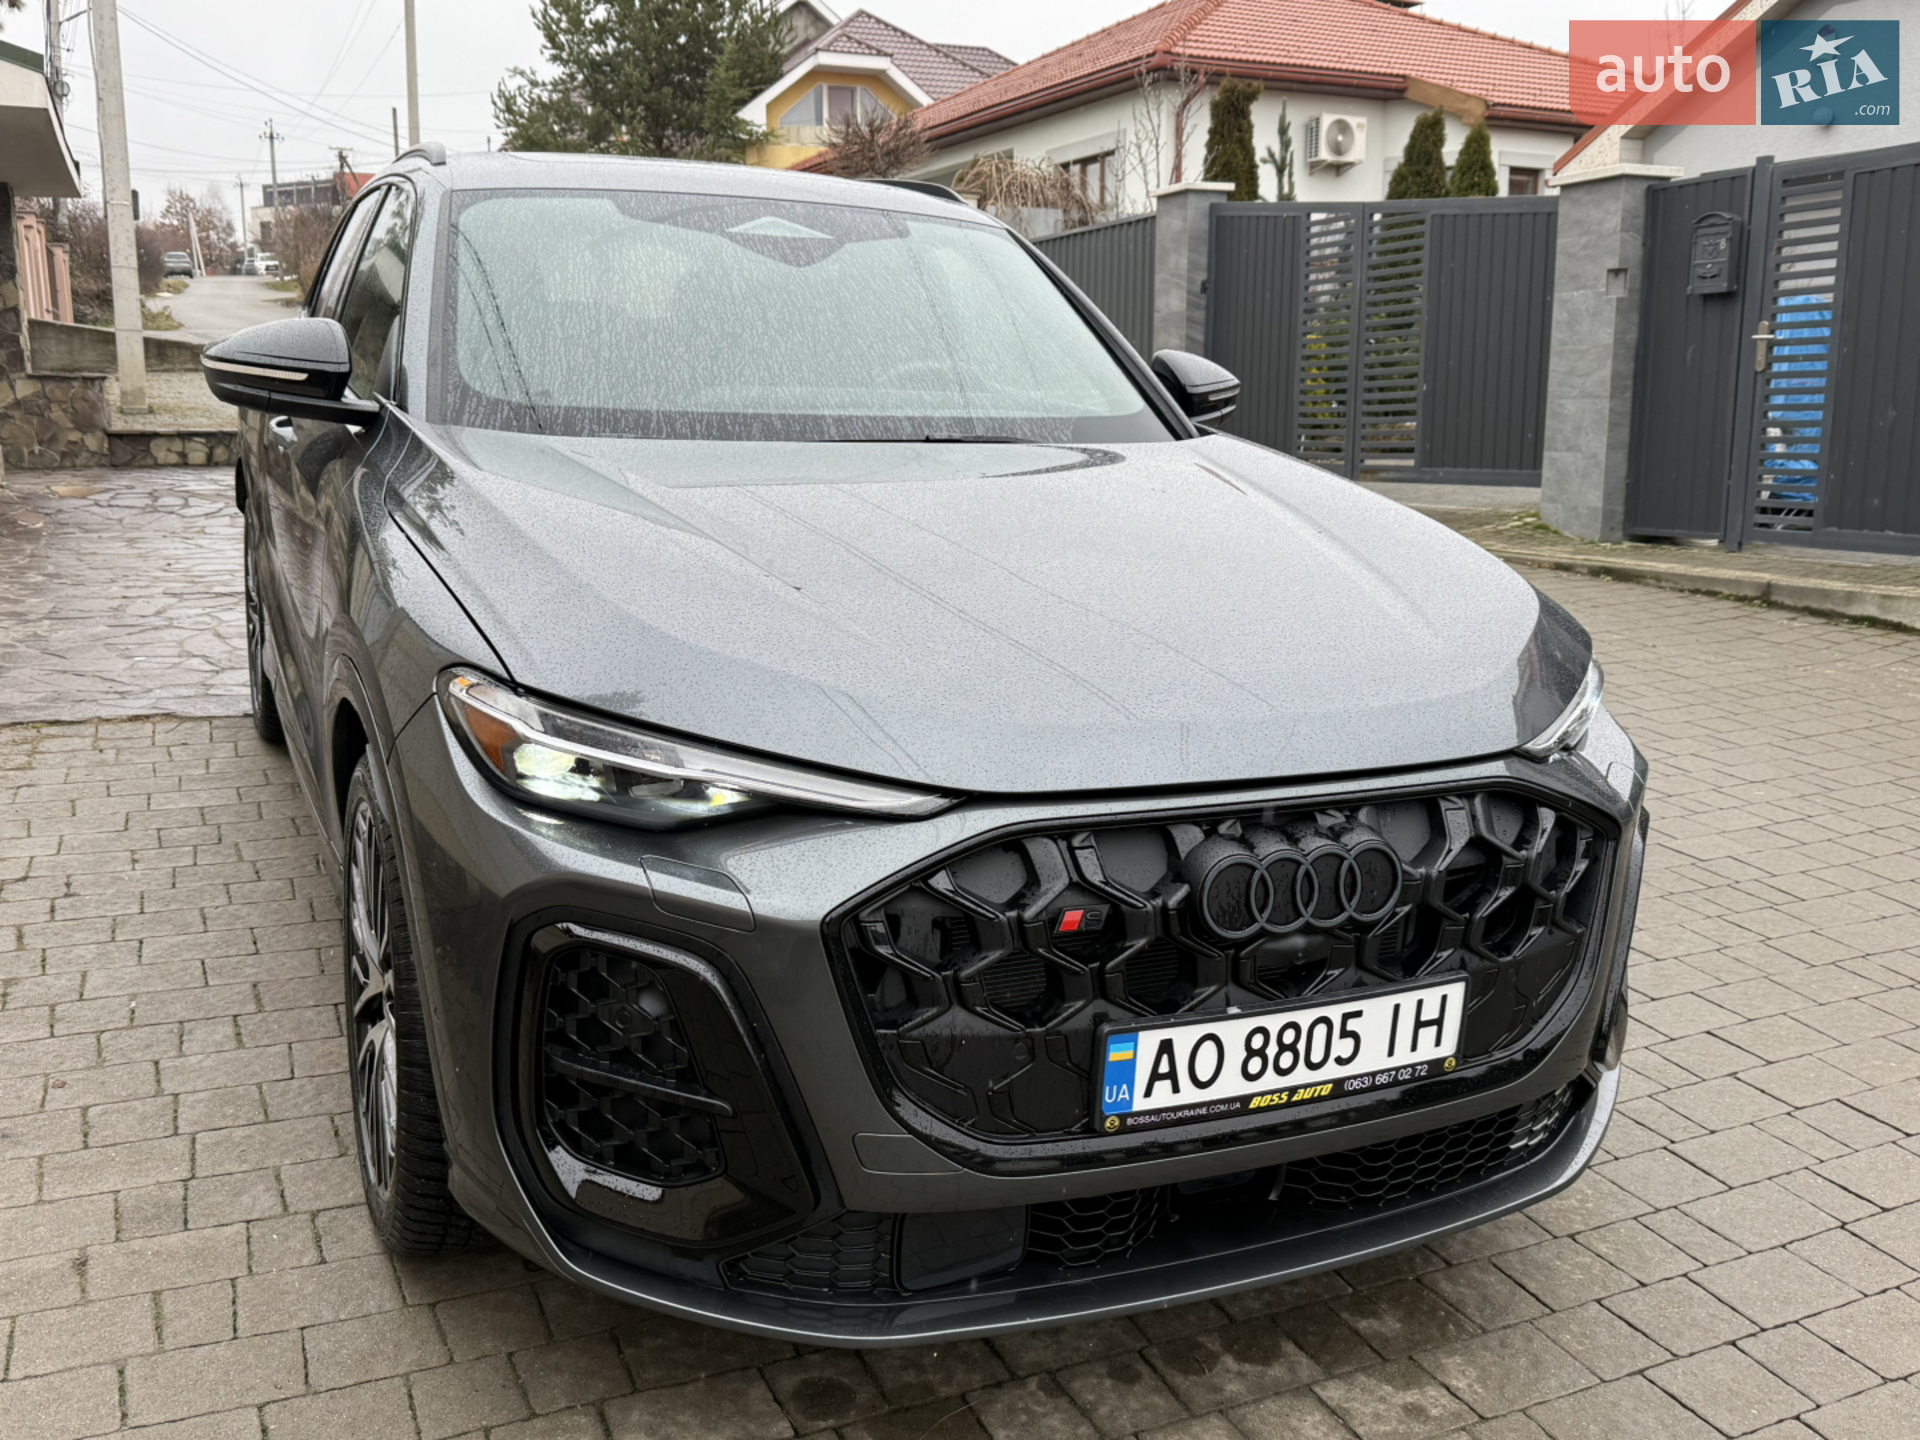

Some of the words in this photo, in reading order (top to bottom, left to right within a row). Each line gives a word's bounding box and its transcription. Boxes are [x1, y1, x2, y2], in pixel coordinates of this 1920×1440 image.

[1143, 1033, 1225, 1098] AO
[1241, 1009, 1364, 1082] 8805
[1104, 1083, 1130, 1104] UA
[1126, 1101, 1242, 1126] BOSSAUTOUKRAINE.COM.UA
[1248, 1091, 1290, 1109] BOSS
[1291, 1083, 1334, 1102] AUTO
[1344, 1075, 1373, 1091] (063)
[1375, 1070, 1397, 1085] 667
[1397, 1067, 1413, 1081] 02
[1414, 1063, 1429, 1077] 72
